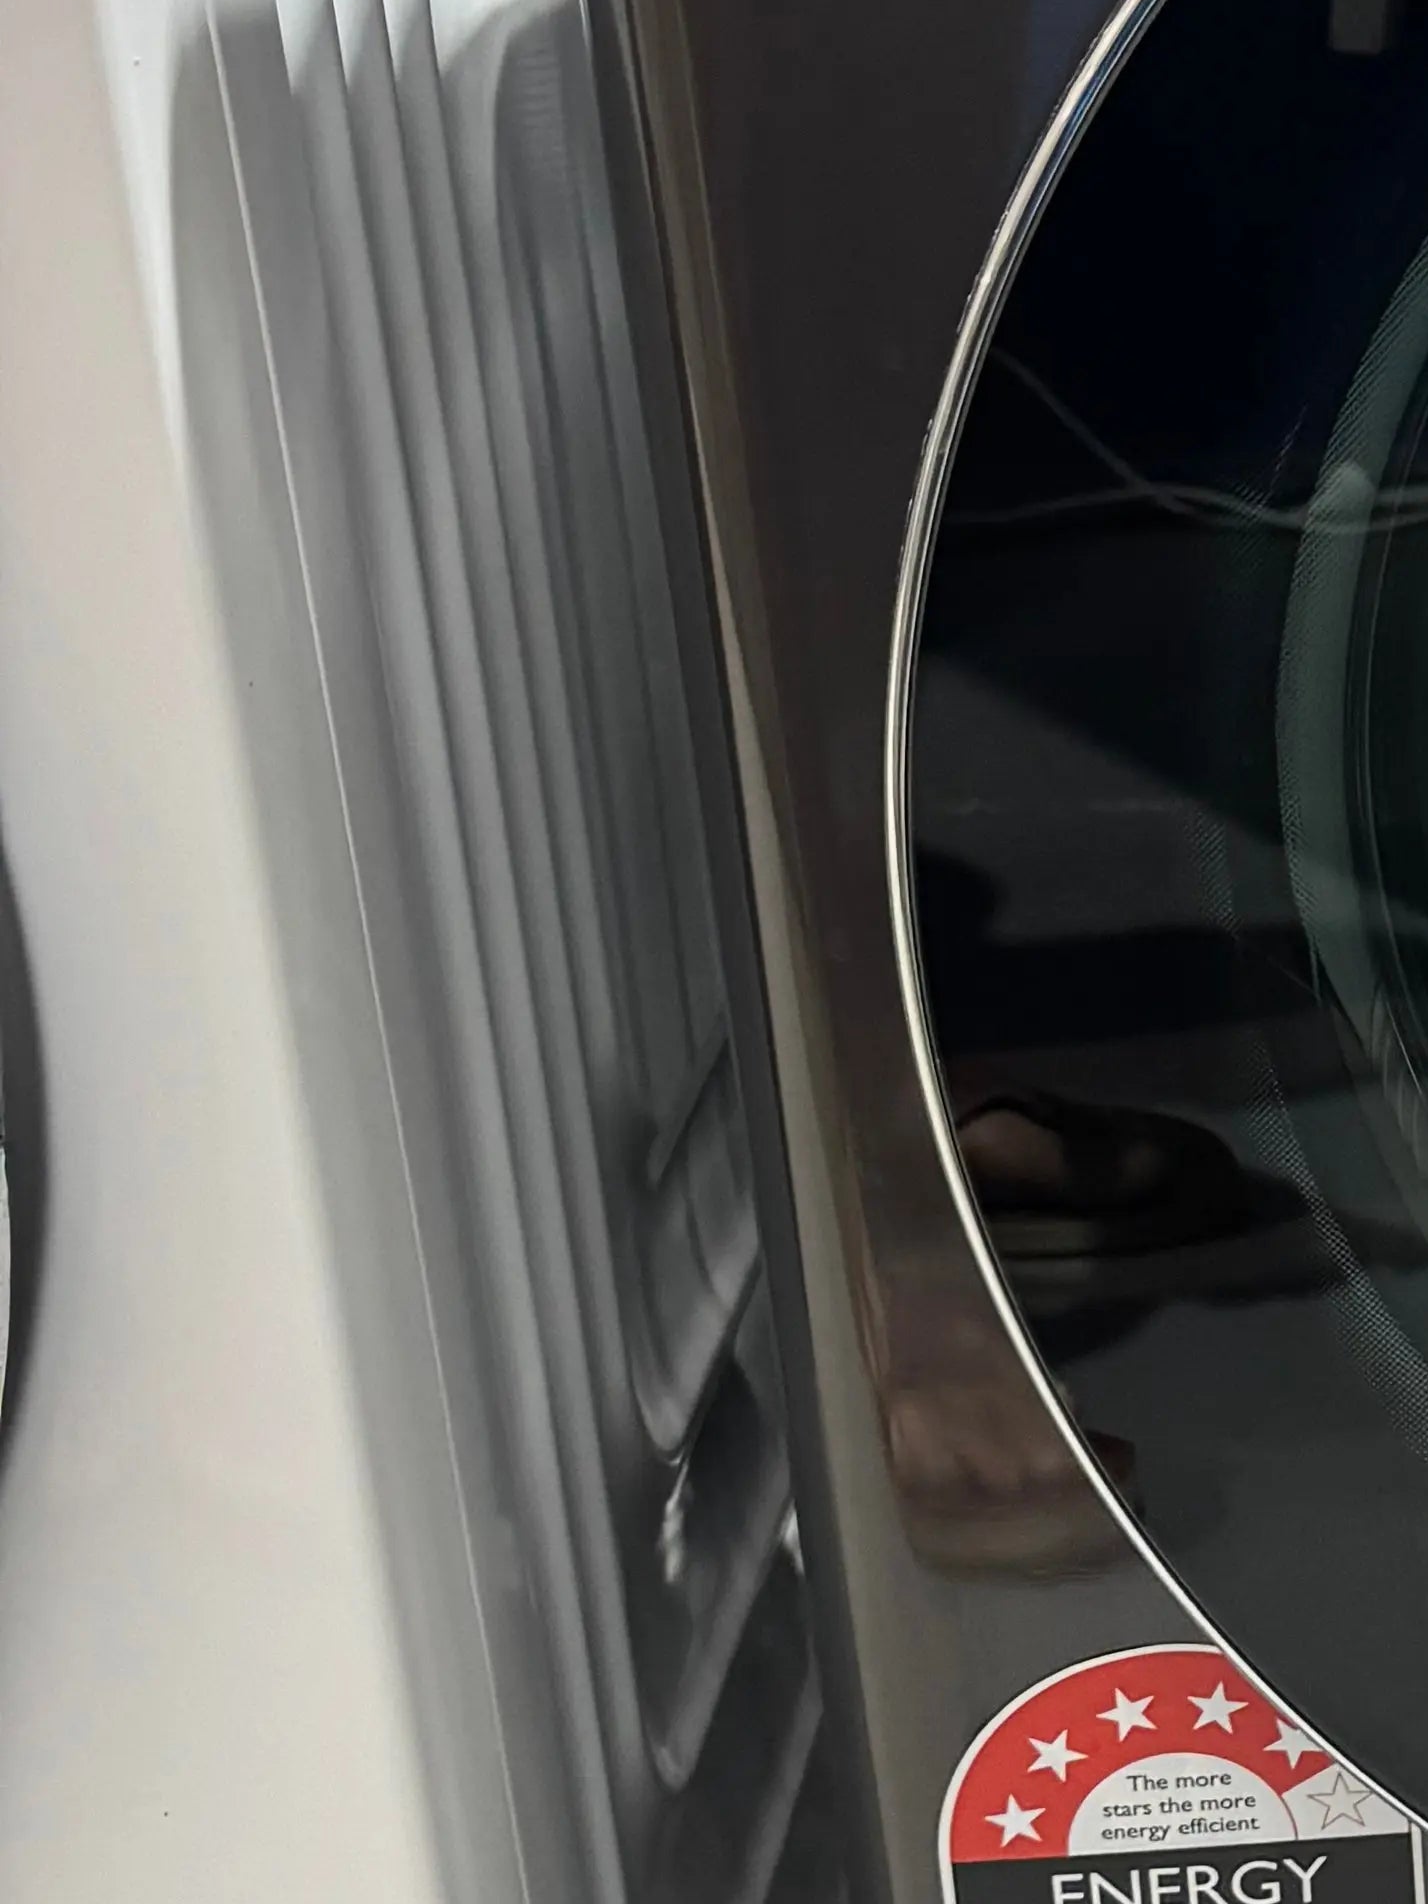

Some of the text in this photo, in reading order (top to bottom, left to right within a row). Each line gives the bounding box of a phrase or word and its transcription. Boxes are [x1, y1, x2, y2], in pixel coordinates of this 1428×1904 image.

[1126, 1772, 1232, 1792] The more
[1102, 1795, 1257, 1818] stars the more
[1101, 1817, 1260, 1842] energy efficient
